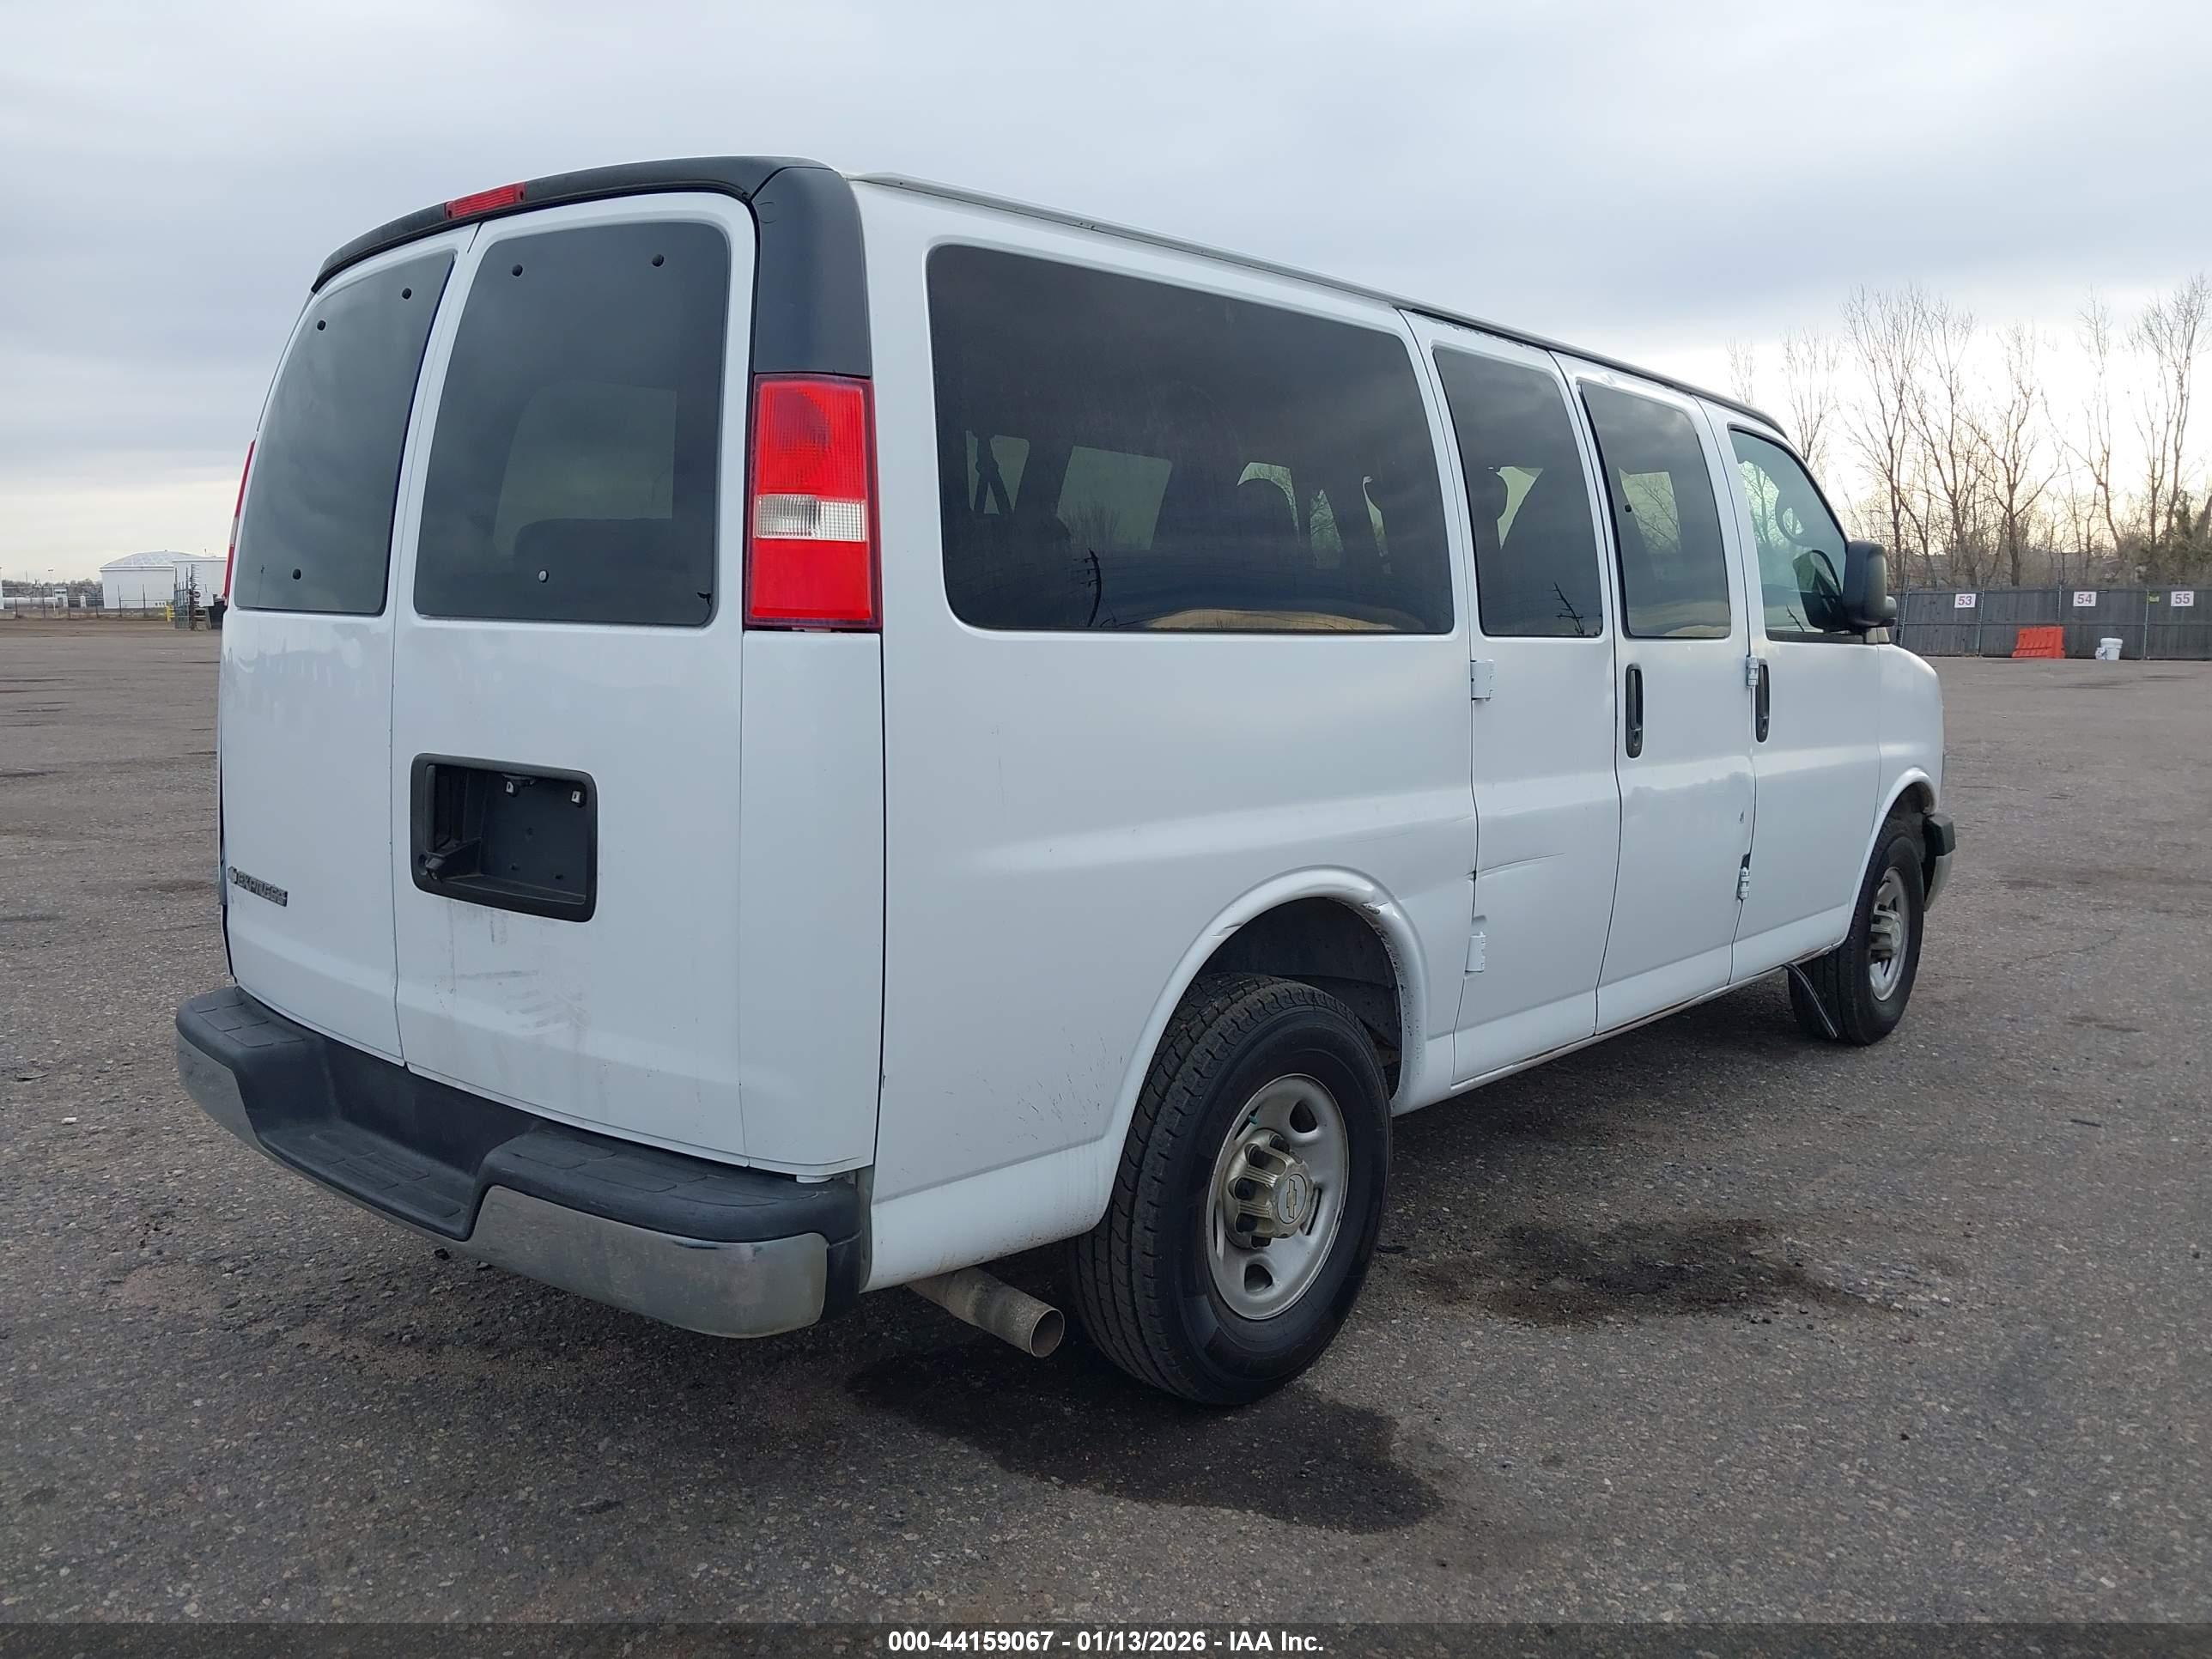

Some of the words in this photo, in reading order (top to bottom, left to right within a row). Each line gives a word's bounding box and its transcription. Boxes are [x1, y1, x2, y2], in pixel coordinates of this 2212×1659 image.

[1958, 595, 1972, 605] 53
[2077, 593, 2092, 605] 54
[2175, 592, 2191, 605] 55
